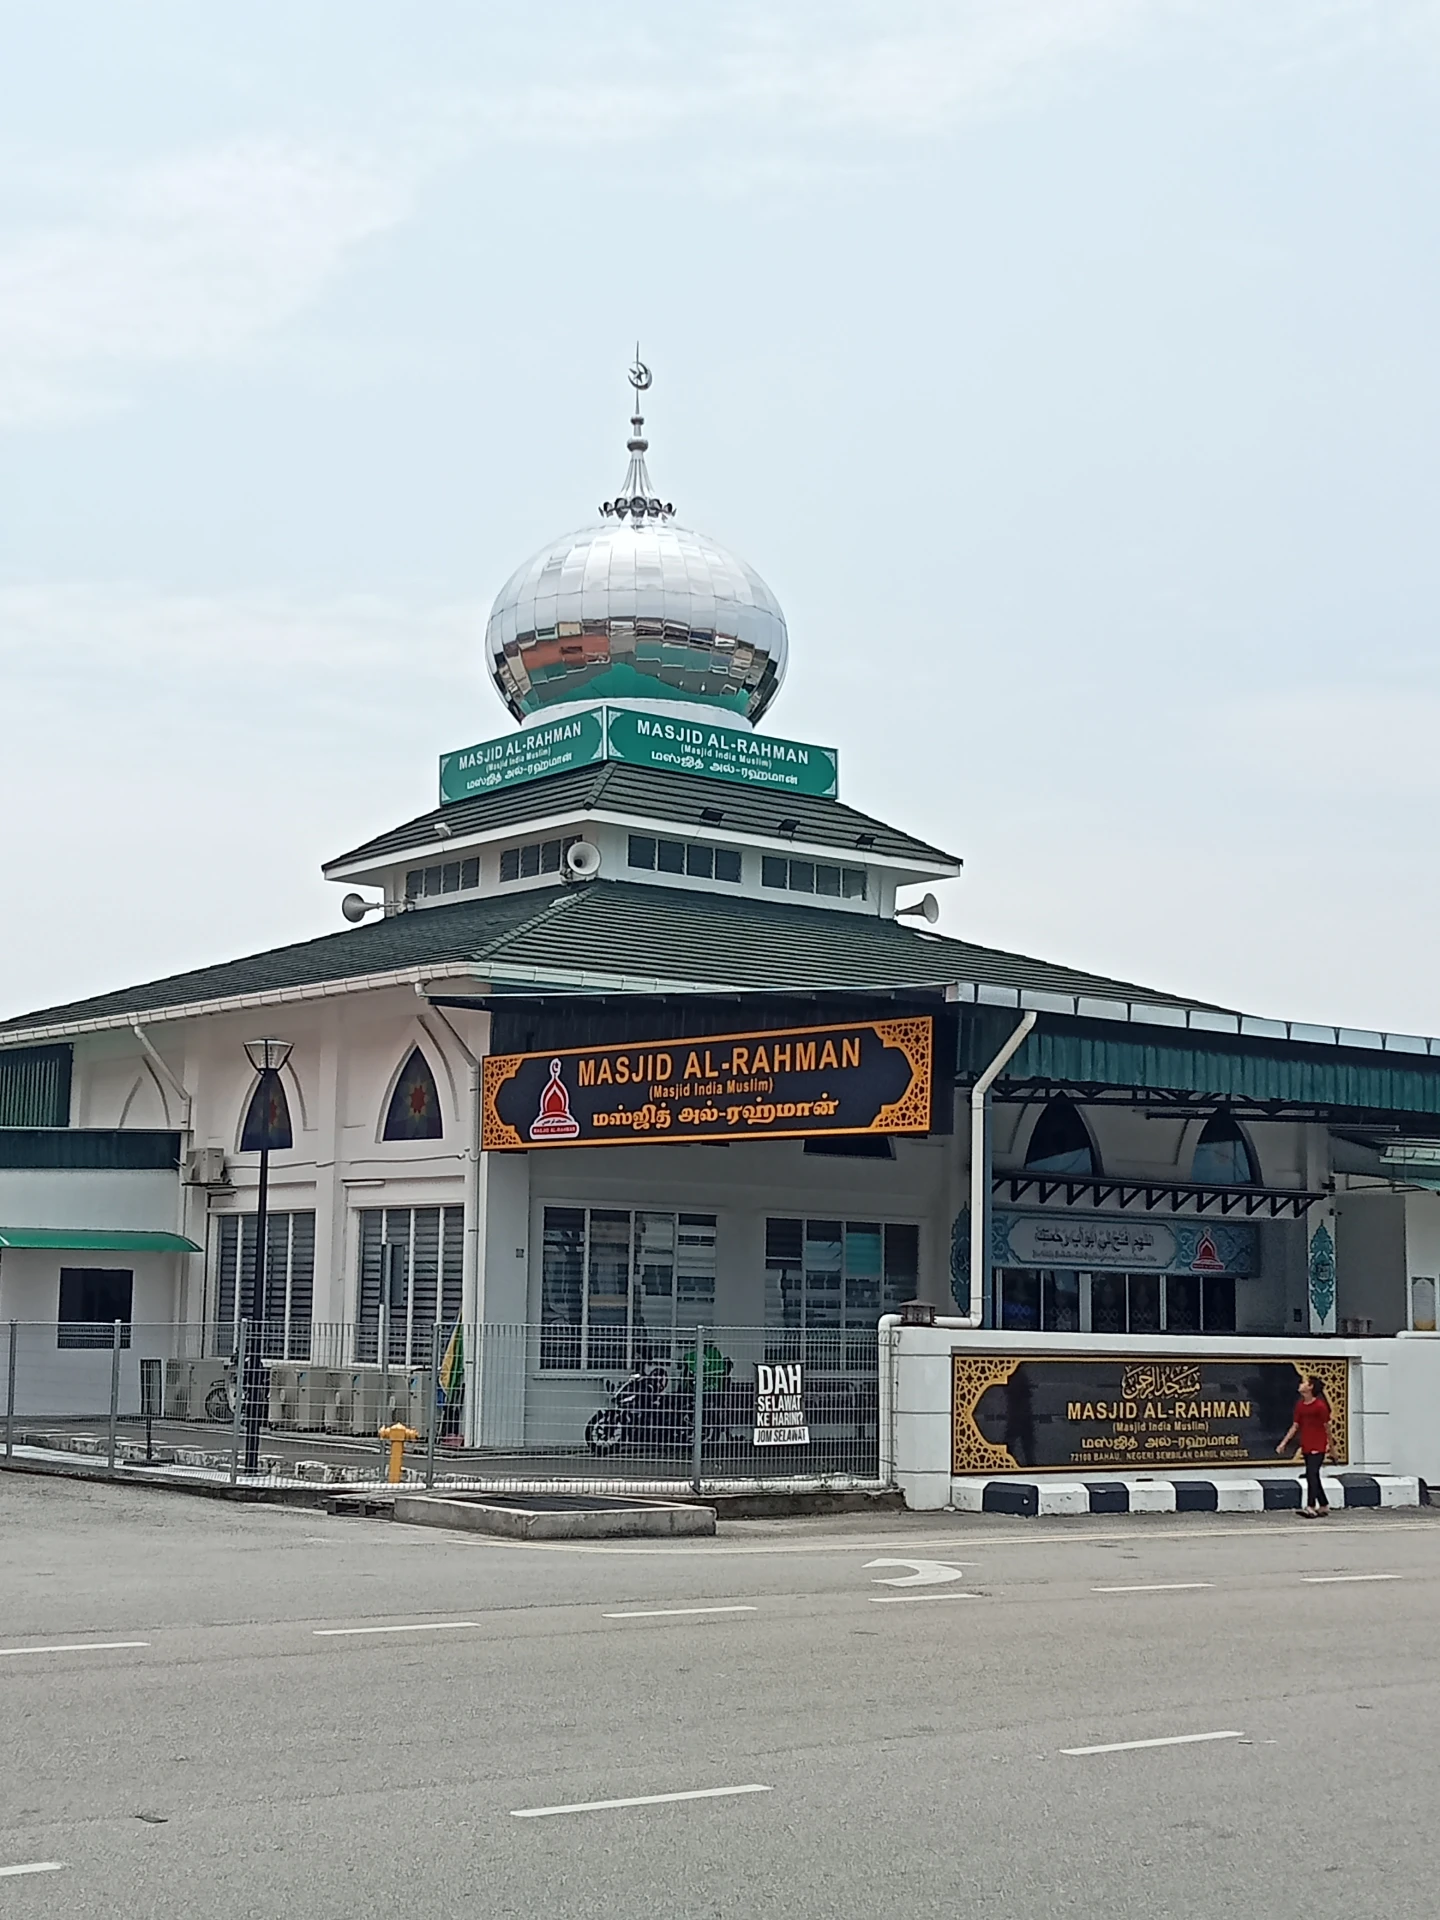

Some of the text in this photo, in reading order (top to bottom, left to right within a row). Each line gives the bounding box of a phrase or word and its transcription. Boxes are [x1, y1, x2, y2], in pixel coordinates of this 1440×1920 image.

[458, 721, 582, 771] MASJID AL-RAHMAN
[637, 719, 809, 765] MASJID AL-RAHMAN
[485, 746, 551, 773] (Masjid India Muslim)
[680, 743, 773, 769] (Masjid India Muslim)
[578, 1037, 860, 1087] MASJID AL-RAHMAN
[649, 1076, 774, 1101] (Masjid India Muslim)
[592, 1092, 840, 1130] மஸ்ஜித் அல்-ரஹ்மான்
[757, 1364, 802, 1395] DAH
[757, 1394, 802, 1412] SELAWAT
[1067, 1400, 1251, 1420] MASJID AL-RAHMAN
[756, 1411, 804, 1427] KE HARINI?
[1112, 1421, 1209, 1434] (Masjid India Muslim)
[757, 1428, 806, 1443] JOM SELAWAT
[1126, 1451, 1154, 1461] NEGERI
[1155, 1450, 1193, 1460] SEMBILAN
[1194, 1449, 1218, 1459] DARUL
[1220, 1448, 1249, 1458] KHUSUS
